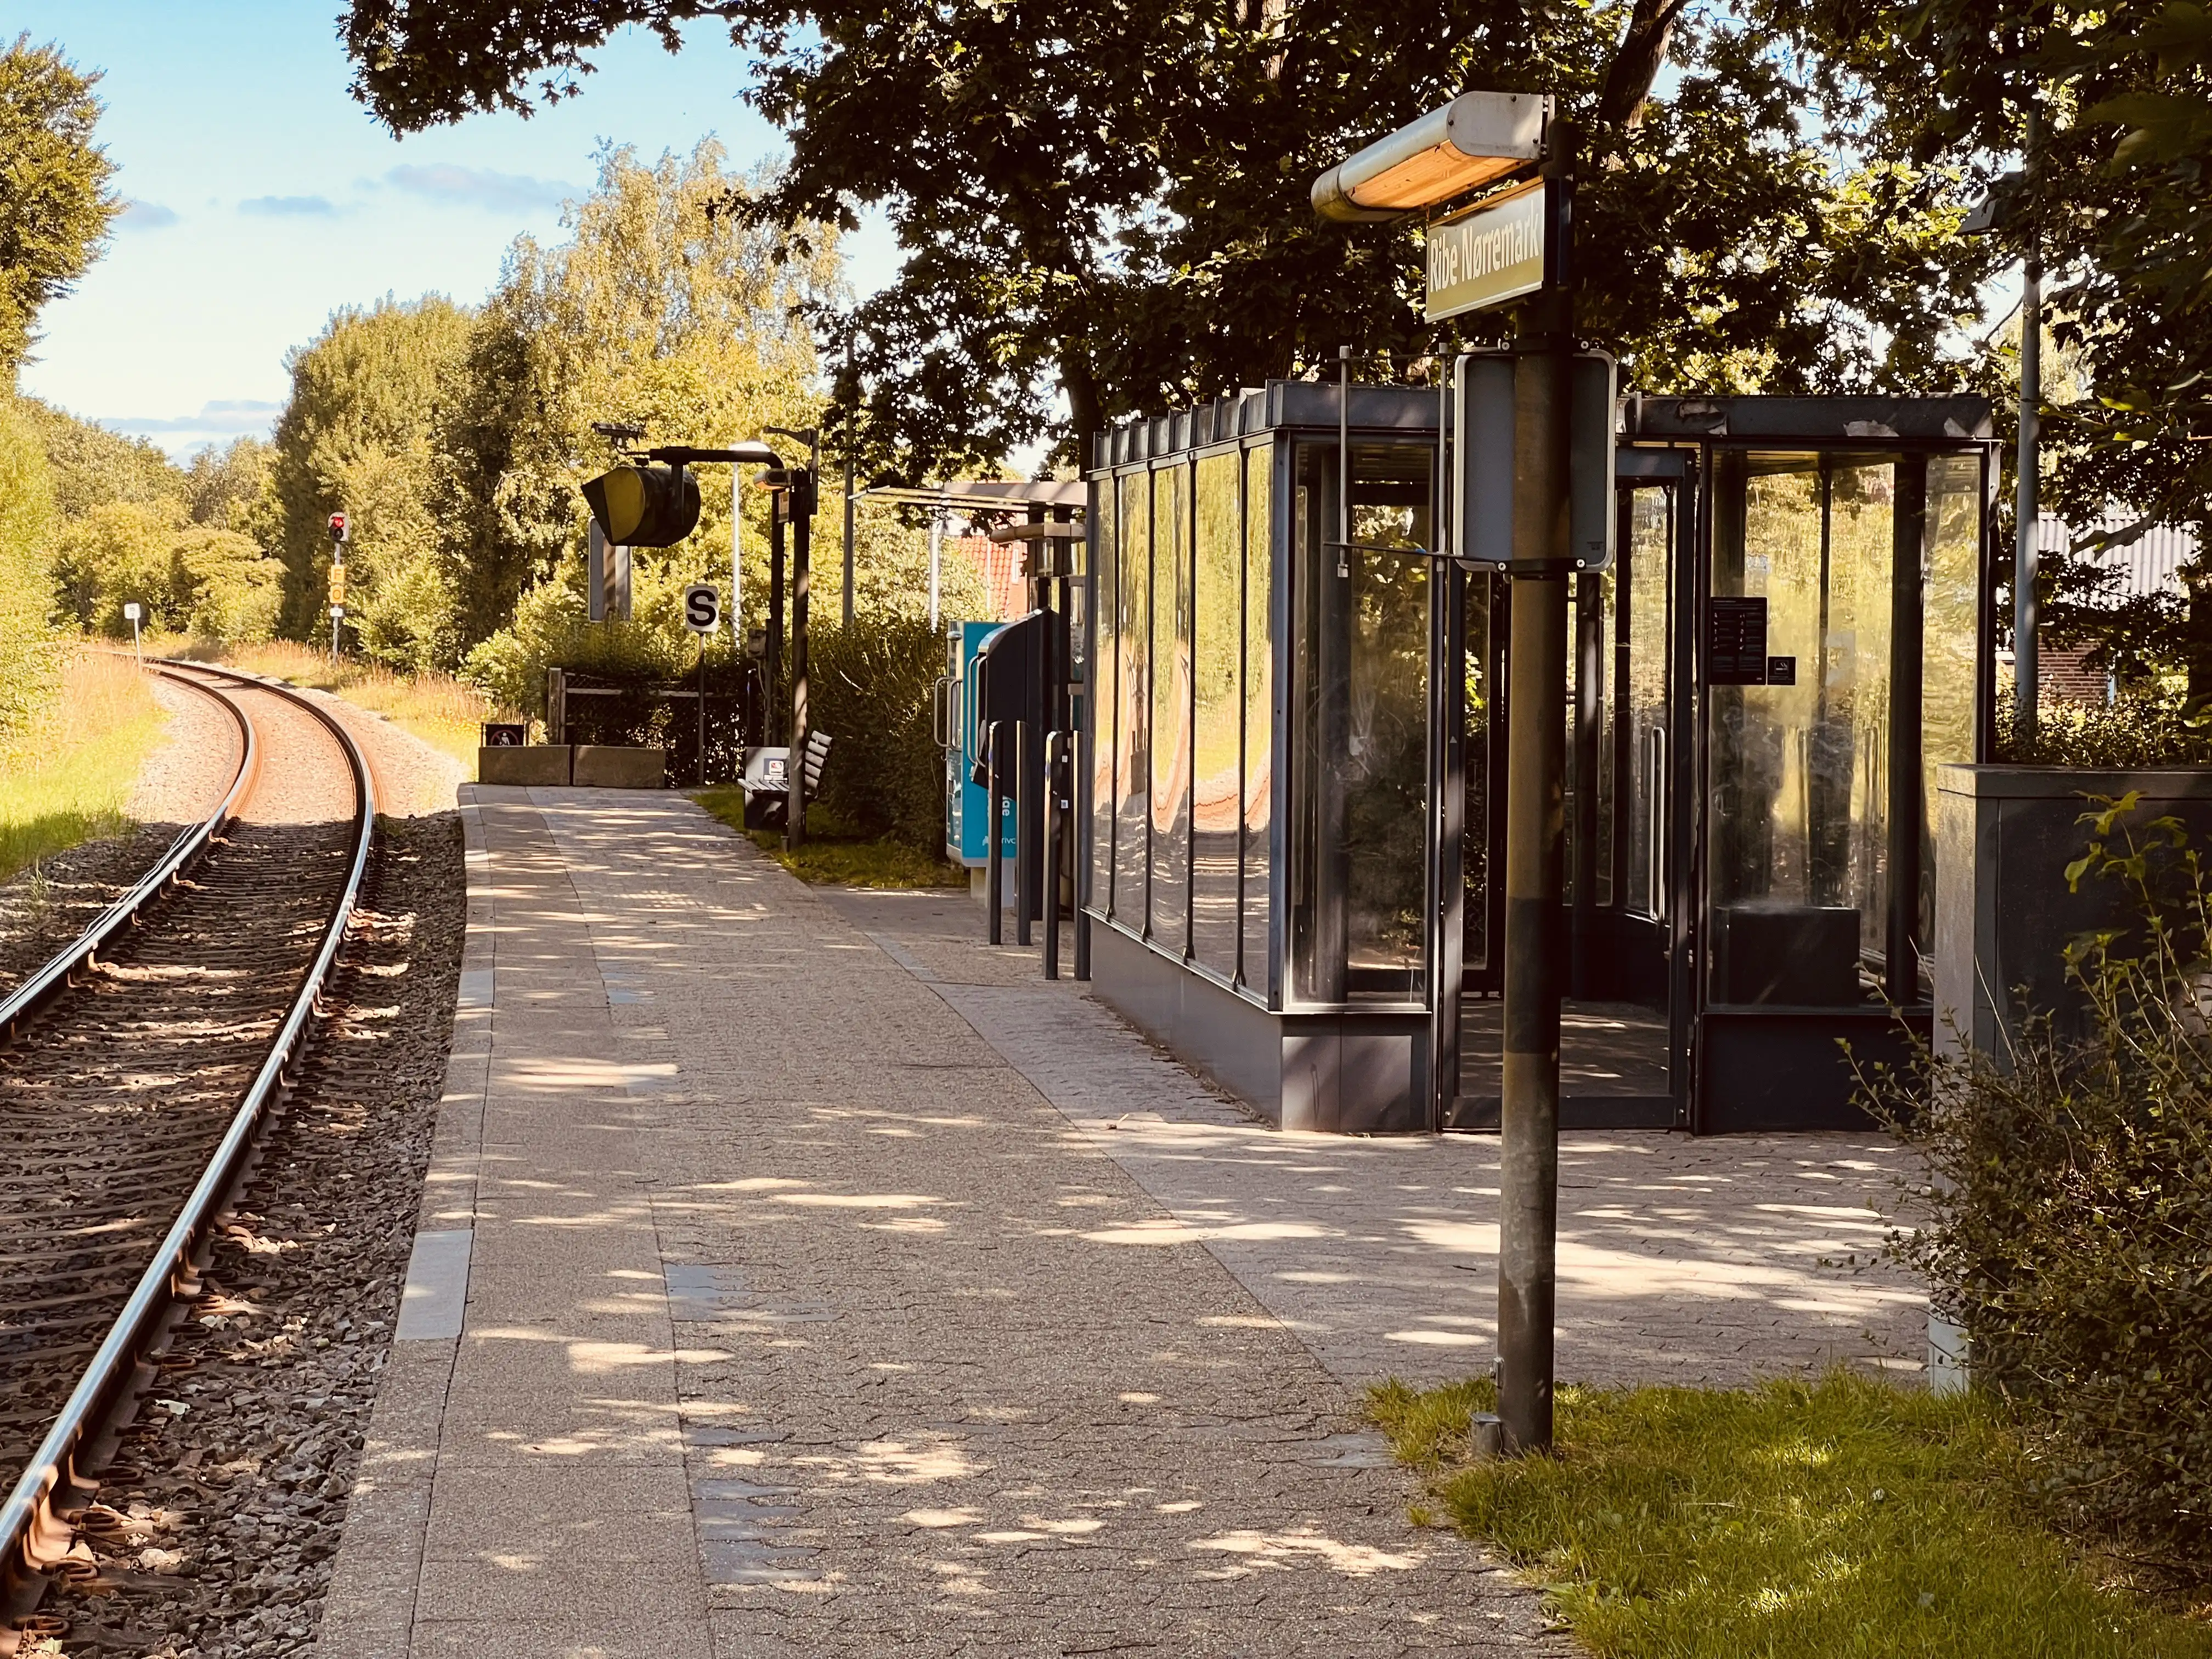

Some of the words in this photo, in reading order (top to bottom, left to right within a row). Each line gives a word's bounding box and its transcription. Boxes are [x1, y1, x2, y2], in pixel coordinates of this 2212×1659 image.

[1430, 233, 1458, 293] Ribe
[1462, 199, 1539, 282] Nørremark
[334, 569, 341, 580] F
[687, 590, 716, 627] S
